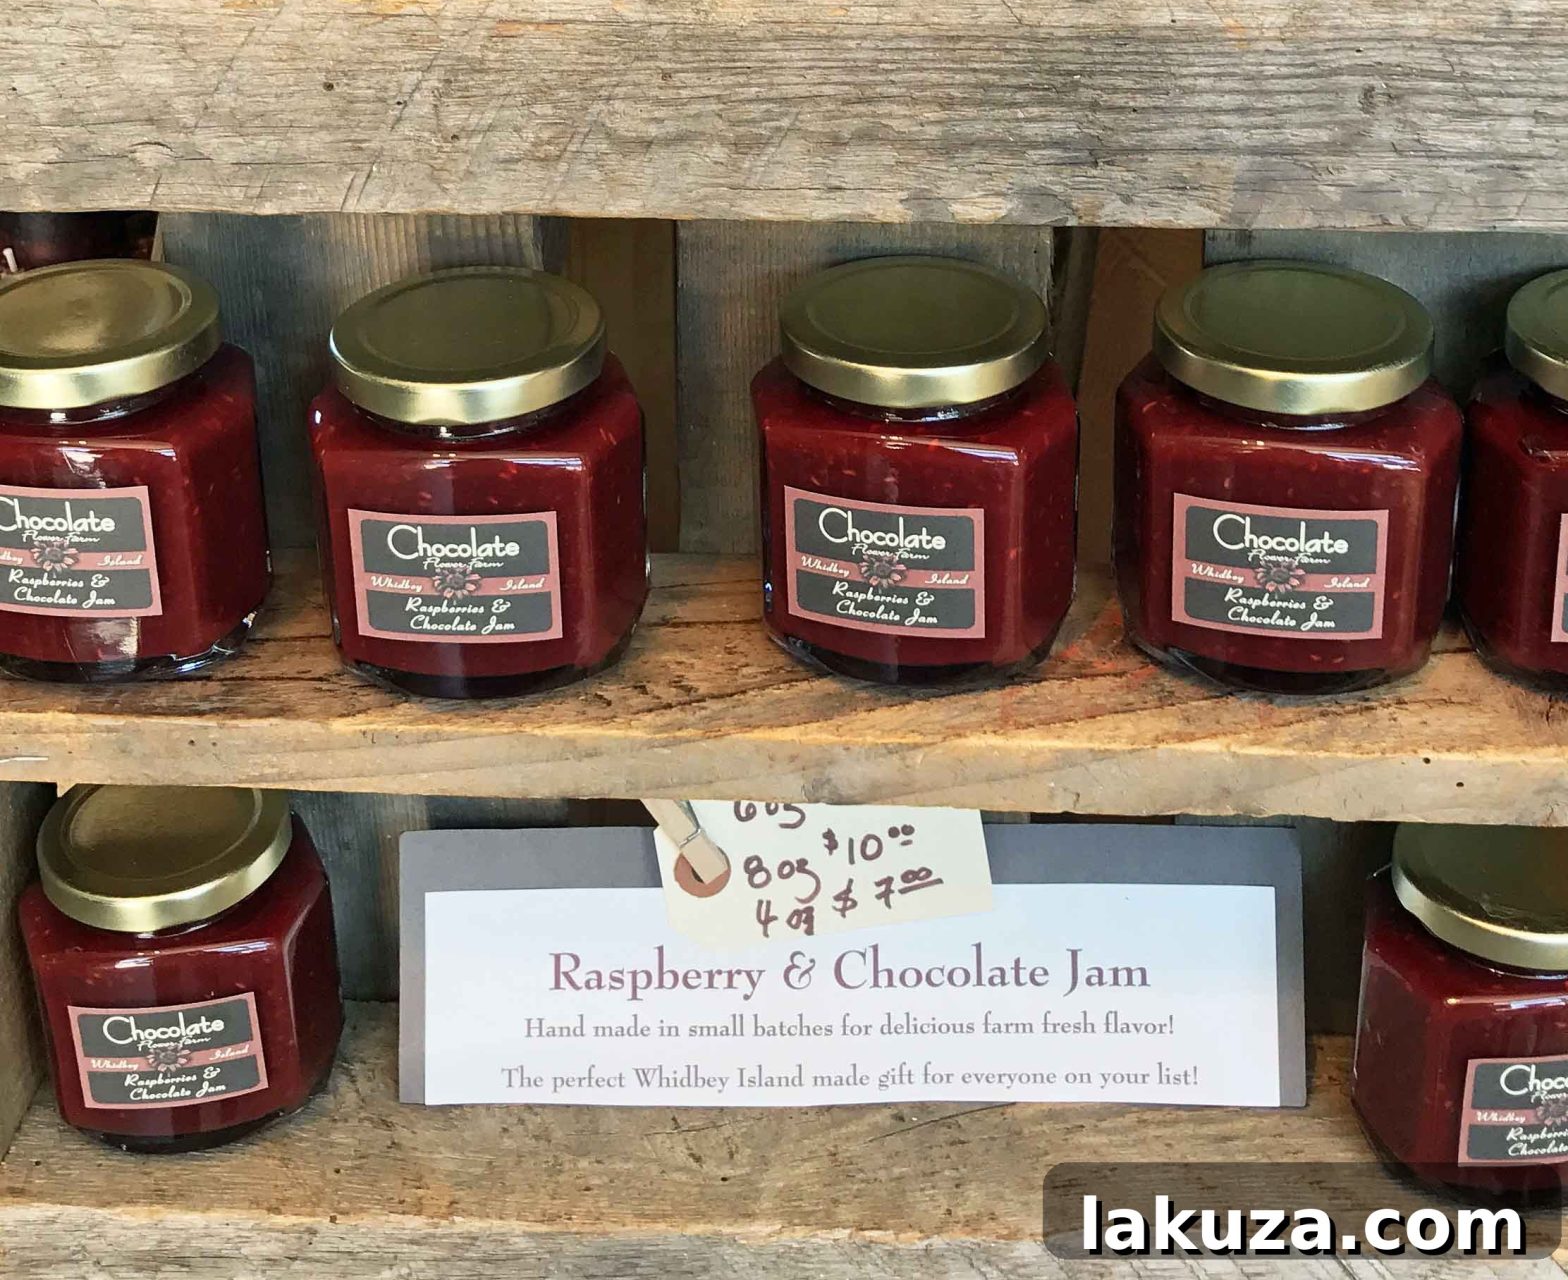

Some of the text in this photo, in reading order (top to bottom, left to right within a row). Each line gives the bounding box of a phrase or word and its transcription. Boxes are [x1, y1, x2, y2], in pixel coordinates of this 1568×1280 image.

[22, 530, 100, 544] Flower Farm
[819, 507, 946, 550] Chocolate
[1213, 514, 1348, 554] Chocolate
[387, 525, 520, 560] Chocolate
[851, 543, 930, 560] Flower Farm
[97, 555, 142, 566] Island
[423, 557, 504, 569] Flower Farm
[1248, 549, 1331, 565] Flower Farm
[9, 569, 110, 588] Raspberries &
[801, 556, 969, 585] Whidbey Island
[1191, 564, 1370, 588] Whidbey Island
[371, 576, 544, 592] Whidbey Island
[832, 581, 934, 605] Raspberries &
[14, 587, 115, 608] Chocolate Jam
[405, 598, 511, 615] Raspberries &
[1224, 588, 1334, 610] Raspberries &
[836, 600, 937, 625] Chocolate Jam
[1228, 606, 1336, 631] Chocolate Jam
[410, 615, 515, 634] Chocolate Jam
[548, 942, 1151, 1001] Raspberry & Chocolate Jam
[103, 1012, 224, 1044] Chocolate
[525, 1011, 1174, 1038] Hand made in small batches for delicious farm fresh flavor!
[137, 1037, 211, 1051] Flower Farm
[91, 1045, 250, 1070] Whidbey Island
[124, 1067, 221, 1088] Raspberries &
[501, 1062, 1199, 1093] The perfect Whidbey Island made gift for everyone on your list!
[130, 1081, 226, 1100] Chocolate Jam
[1476, 1112, 1525, 1123] Whidbey
